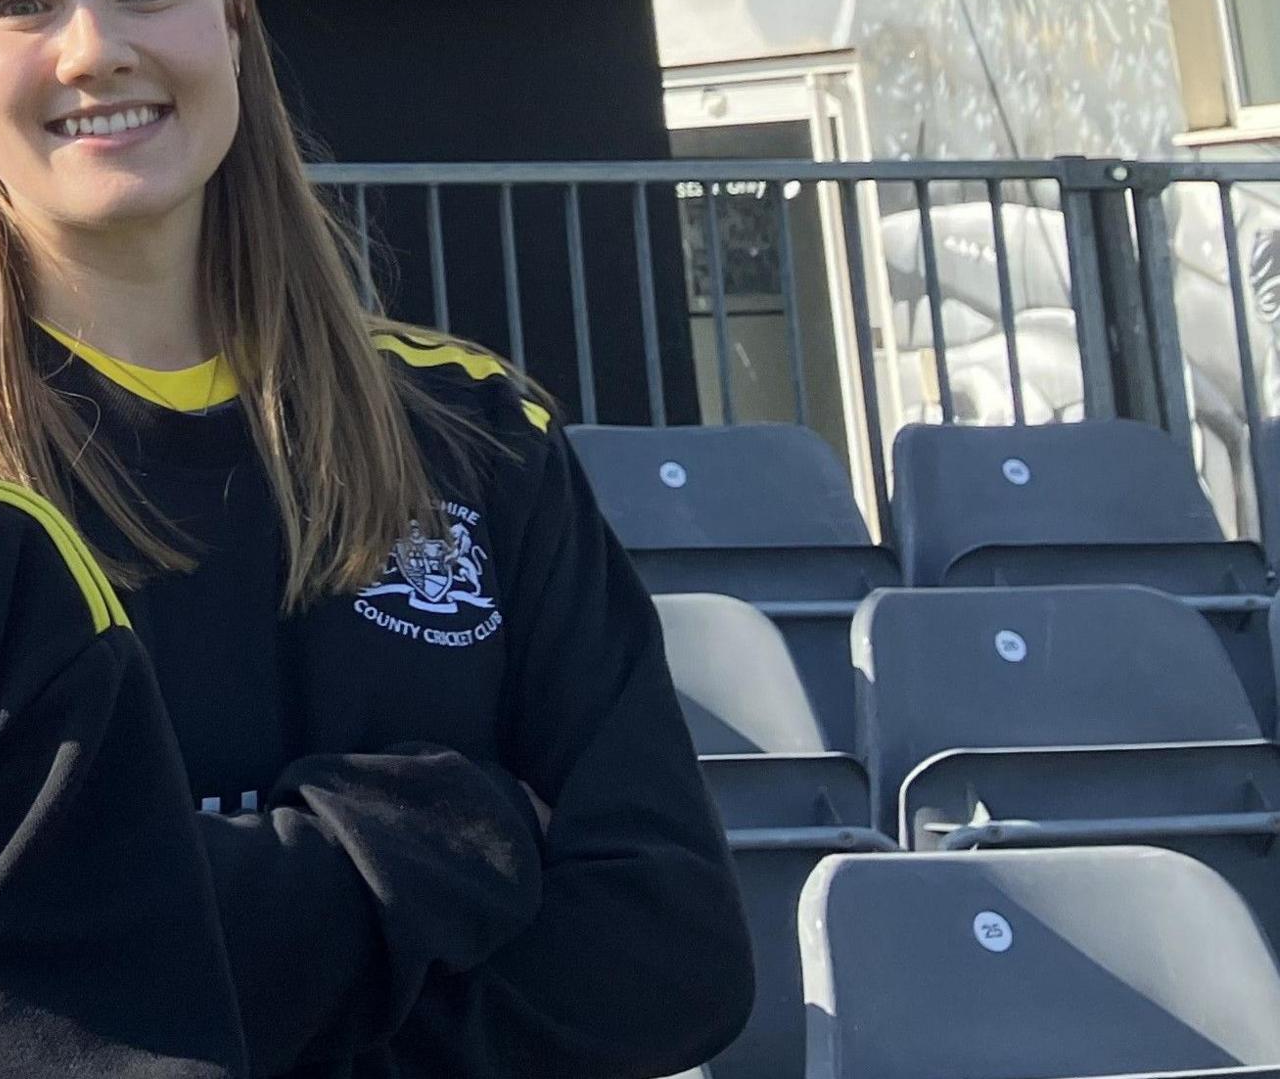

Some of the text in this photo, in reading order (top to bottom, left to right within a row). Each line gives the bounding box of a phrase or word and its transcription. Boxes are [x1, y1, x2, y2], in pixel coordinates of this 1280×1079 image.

[354, 599, 503, 647] COUNTY CRICKET CLUB
[981, 923, 1003, 939] 25
